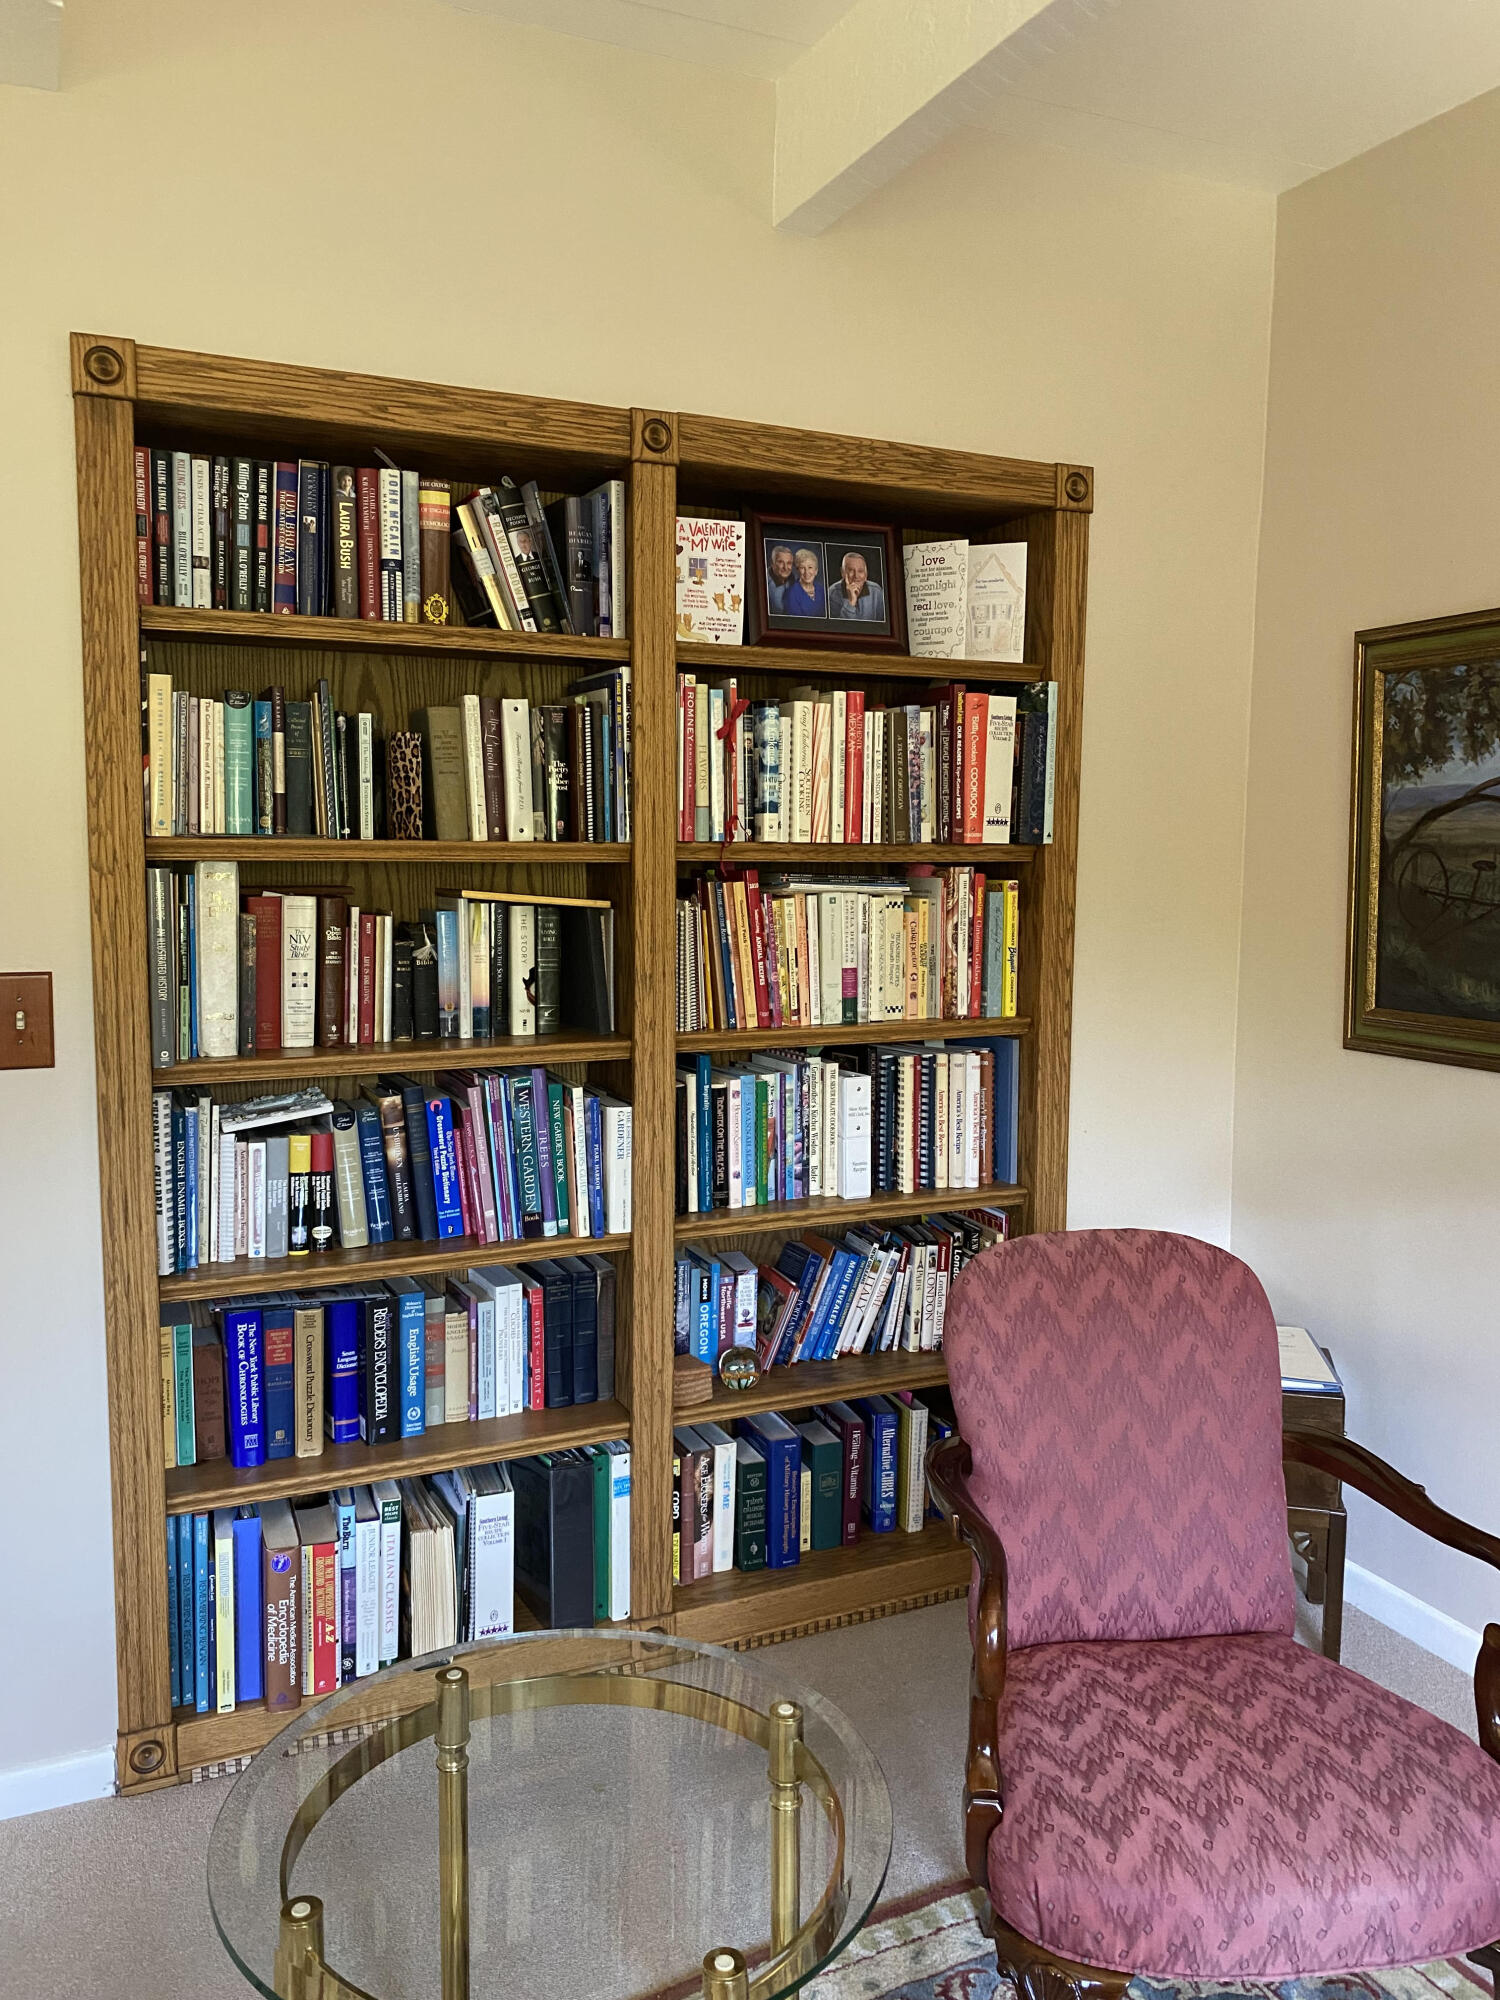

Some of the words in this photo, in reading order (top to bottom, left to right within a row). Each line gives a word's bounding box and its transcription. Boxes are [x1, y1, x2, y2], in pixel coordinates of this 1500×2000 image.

[135, 452, 145, 478] KILLING
[158, 460, 166, 484] KILLING
[177, 459, 186, 485] KILLING
[236, 463, 249, 490] Killing
[258, 468, 267, 492] KILLING
[136, 480, 146, 510] KENNEDY
[158, 486, 166, 511] LINCOLN
[177, 488, 187, 510] JESUS
[238, 492, 249, 520] Patton
[258, 494, 267, 520] REAGAN
[285, 492, 296, 518] TOM
[339, 502, 353, 537] LAURA
[679, 524, 685, 533] A
[689, 522, 735, 537] VALENTINE
[138, 541, 146, 554] BILL
[178, 531, 187, 546] BILL
[285, 522, 296, 576] BROKAW
[692, 537, 709, 552] MY
[712, 536, 736, 552] Wife
[139, 555, 148, 578] O'REILLY
[178, 548, 187, 576] O'REILLY
[239, 550, 247, 562] BILL
[258, 552, 266, 564] BILL
[340, 540, 354, 569] BUSH
[492, 522, 517, 569] RAWHIDE
[510, 572, 526, 604] DOWN
[922, 555, 946, 566] love
[239, 564, 248, 590] O'REILLY
[258, 566, 266, 588] O'REILLY
[914, 626, 953, 636] courage
[971, 715, 979, 734] Betty
[971, 735, 979, 766] Crocker's
[699, 745, 707, 790] FLAVORS
[897, 767, 903, 777] OF
[970, 767, 978, 819] COOKBOOK
[290, 934, 311, 944] NIV
[910, 921, 918, 941] Cake
[290, 944, 310, 952] Study
[520, 935, 528, 964] STORY
[910, 942, 918, 968] Doctor
[518, 1090, 532, 1152] WESTERN
[553, 1100, 561, 1118] NEW
[393, 1127, 403, 1168] UNBROKEN
[538, 1128, 549, 1168] TREES
[554, 1122, 564, 1156] GARDEN
[954, 1132, 962, 1154] Recipes
[176, 1140, 185, 1182] ENGLISH
[436, 1115, 445, 1149] Crossword
[442, 1172, 450, 1204] Dictionary
[556, 1159, 565, 1184] BOOK
[395, 1172, 404, 1214] HILLENBRAND
[522, 1156, 536, 1212] GARDEN
[177, 1182, 185, 1218] ENAMEL
[869, 1247, 877, 1260] NEW
[843, 1260, 856, 1283] MAUI
[861, 1261, 873, 1284] ORLEANS
[829, 1284, 849, 1325] REVEALED
[856, 1276, 875, 1313] ITALY
[872, 1277, 890, 1308] ROME
[926, 1272, 935, 1320] LONDON
[248, 1322, 256, 1337] The
[700, 1305, 708, 1354] OREGON
[786, 1300, 804, 1336] PORTLAND
[237, 1324, 247, 1348] BOOK
[249, 1339, 257, 1354] New
[406, 1328, 420, 1365] English
[238, 1350, 246, 1359] OF
[250, 1355, 258, 1372] York
[305, 1334, 315, 1374] Crossword
[239, 1361, 249, 1425] CHRONOLOGIES
[250, 1374, 259, 1396] Public
[306, 1376, 315, 1400] Puzzle
[407, 1366, 419, 1396] Usage
[250, 1398, 259, 1423] Library
[305, 1403, 314, 1442] Dictionary
[882, 1428, 894, 1470] Alternative
[882, 1471, 893, 1497] CURES
[343, 1516, 351, 1530] The
[342, 1531, 351, 1550] Barn
[386, 1535, 395, 1578] ITALIAN
[198, 1580, 208, 1634] REMEMBERING
[268, 1604, 278, 1615] of
[386, 1582, 395, 1634] CLASSICS
[268, 1616, 278, 1661] Medicine
[276, 1600, 289, 1664] Encyclopedia
[199, 1636, 207, 1666] REAGAN
